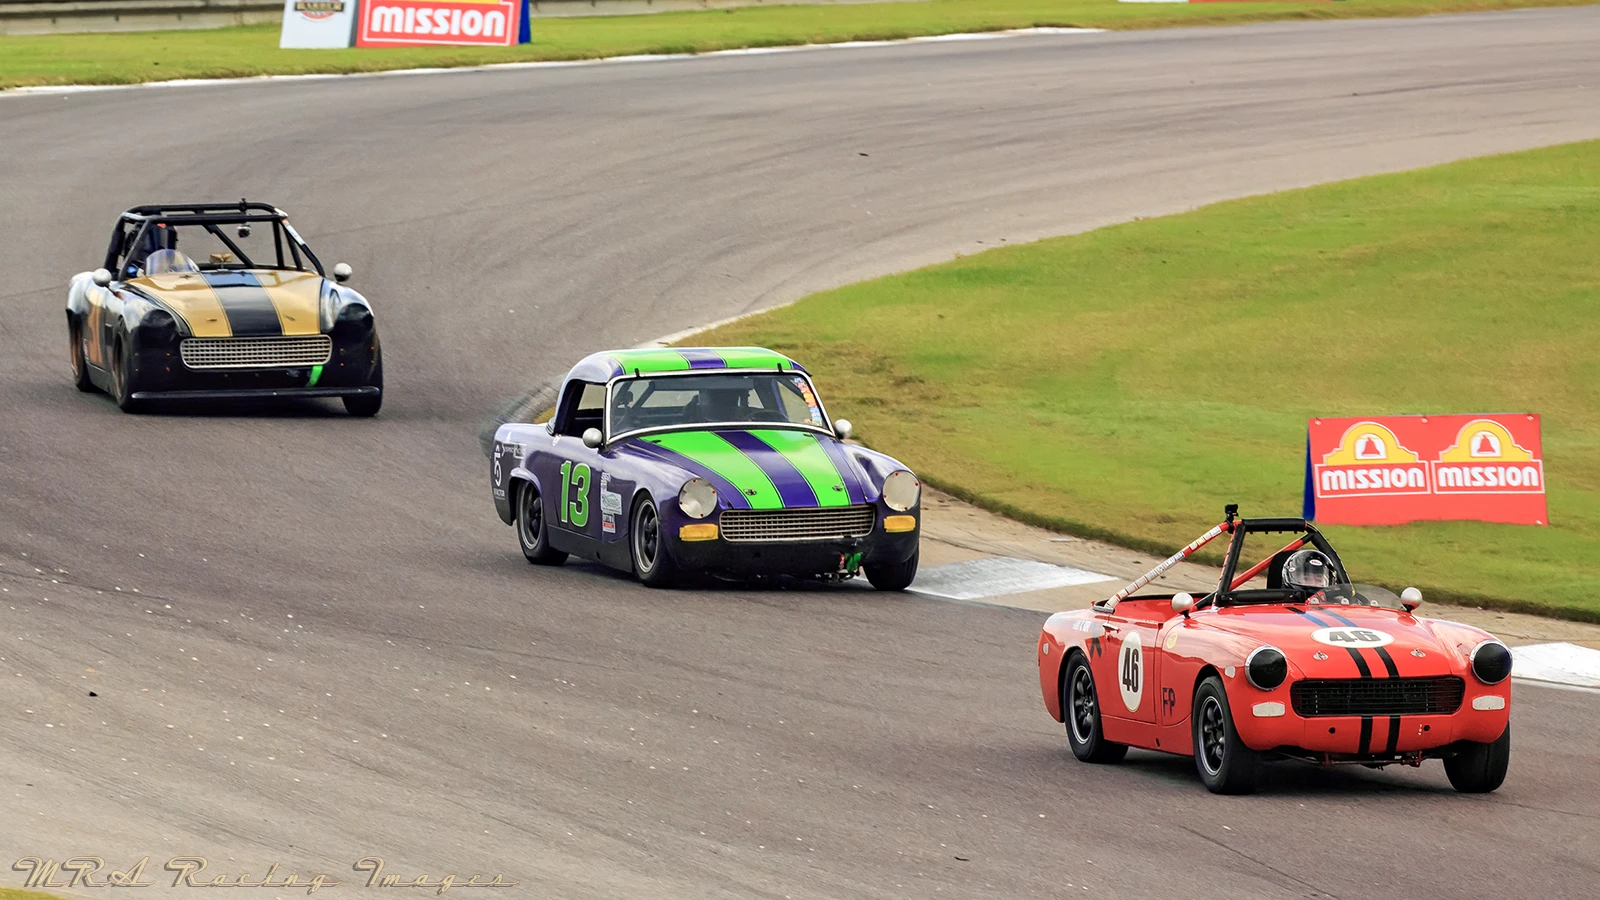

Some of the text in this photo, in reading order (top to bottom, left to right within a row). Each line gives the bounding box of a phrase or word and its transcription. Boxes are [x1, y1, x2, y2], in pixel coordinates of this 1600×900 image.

[560, 460, 591, 527] 13
[1329, 631, 1382, 642] 46
[1122, 648, 1139, 693] 46
[1162, 687, 1176, 717] FP
